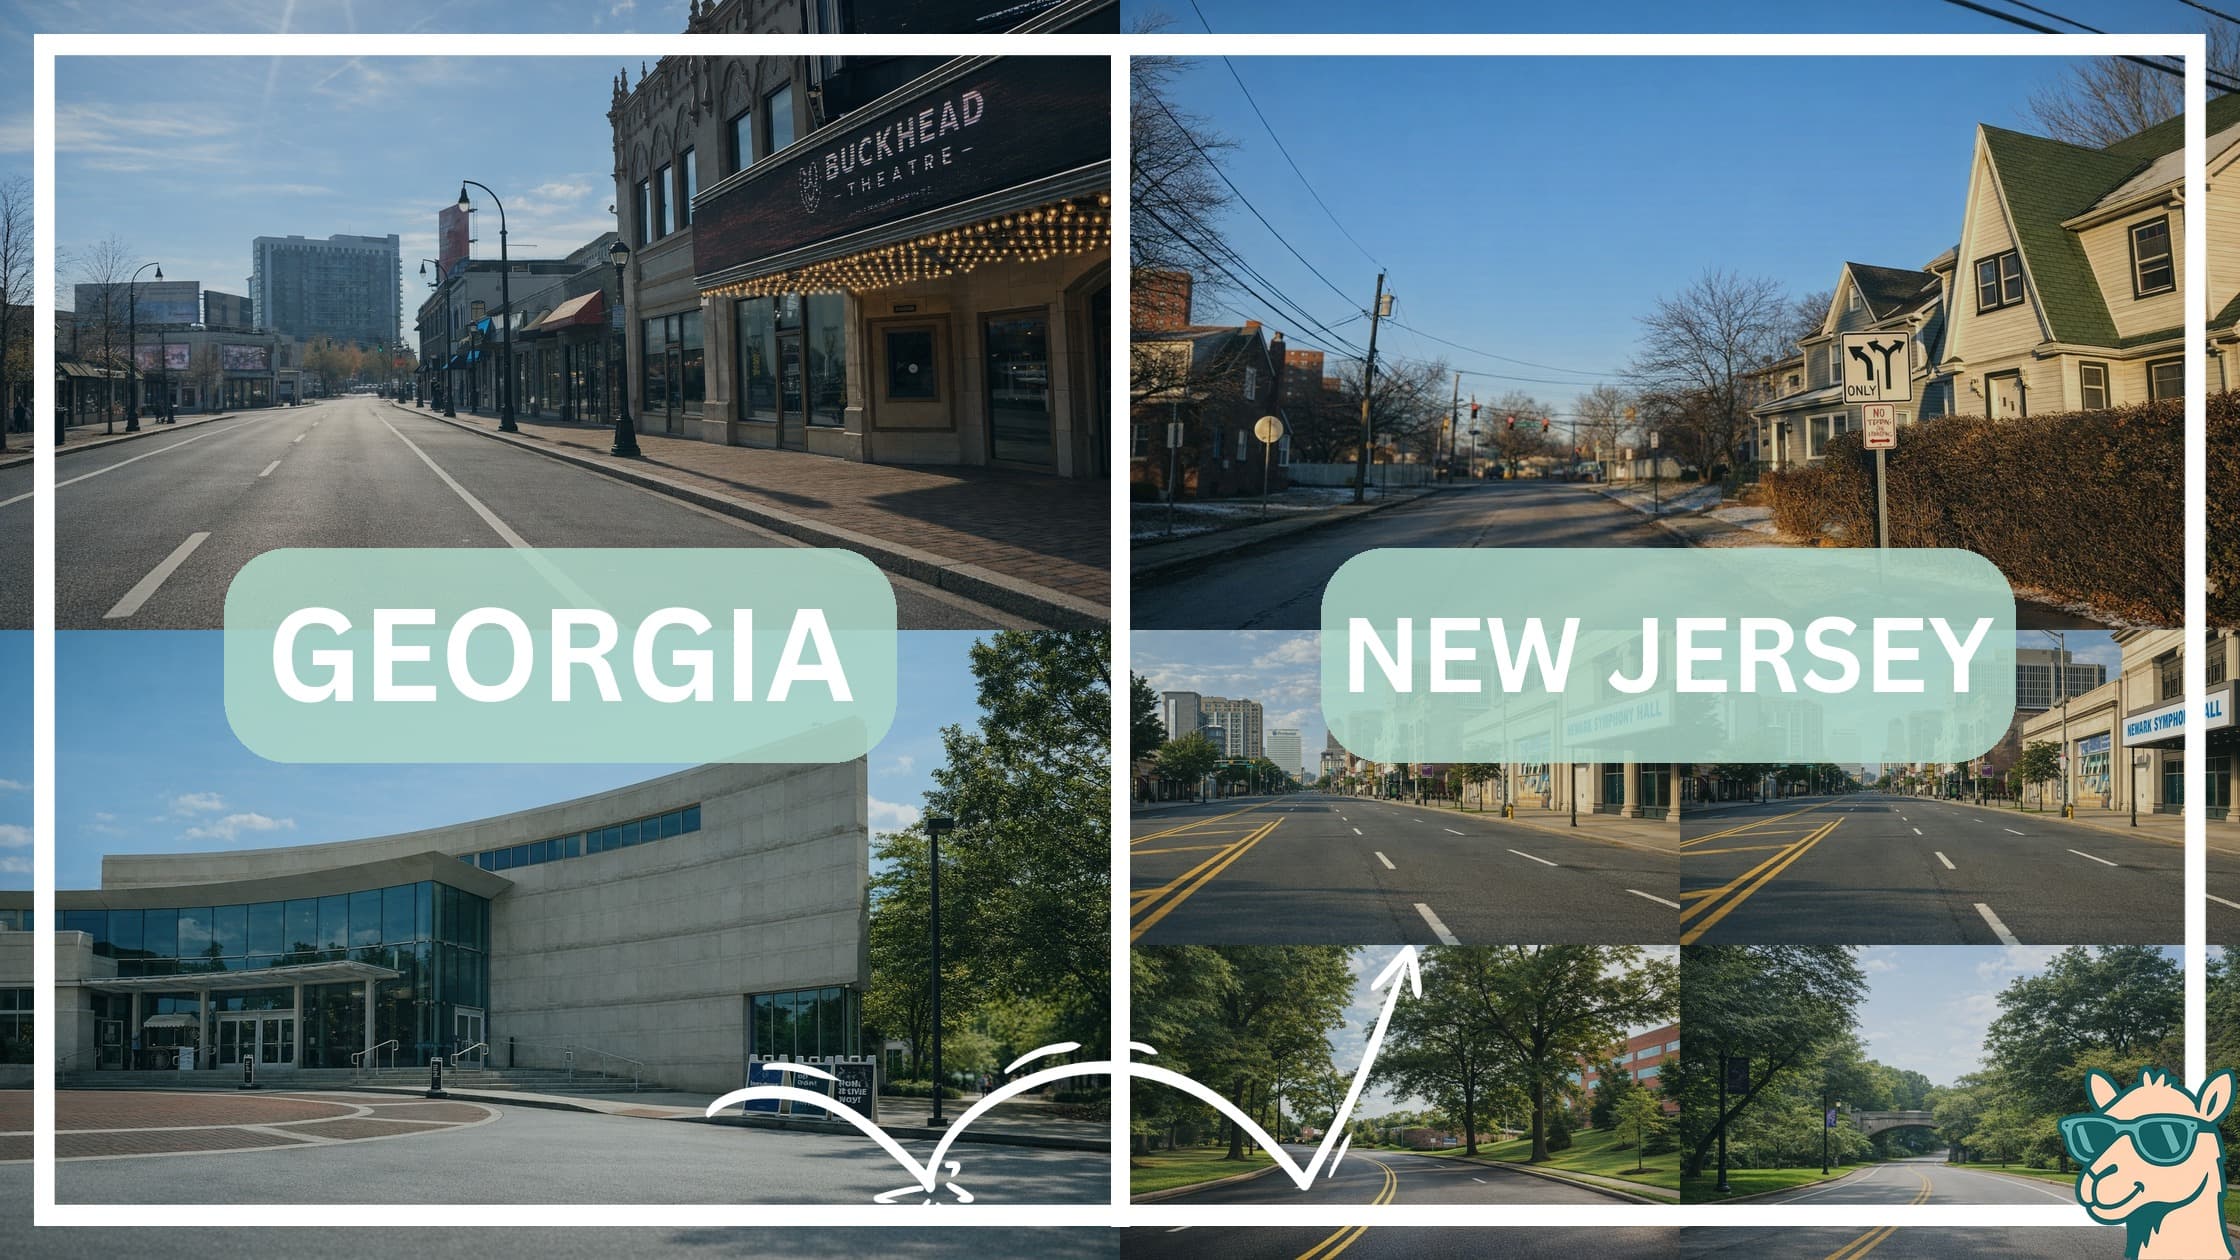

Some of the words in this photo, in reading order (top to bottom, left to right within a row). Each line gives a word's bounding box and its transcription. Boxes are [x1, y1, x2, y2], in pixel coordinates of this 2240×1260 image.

[826, 90, 984, 181] BUCKHEAD
[848, 147, 952, 196] THEATRE
[1847, 385, 1876, 396] ONLY
[1873, 408, 1885, 418] NO
[2127, 719, 2152, 737] NEWARK
[2154, 709, 2186, 732] SYMPHO
